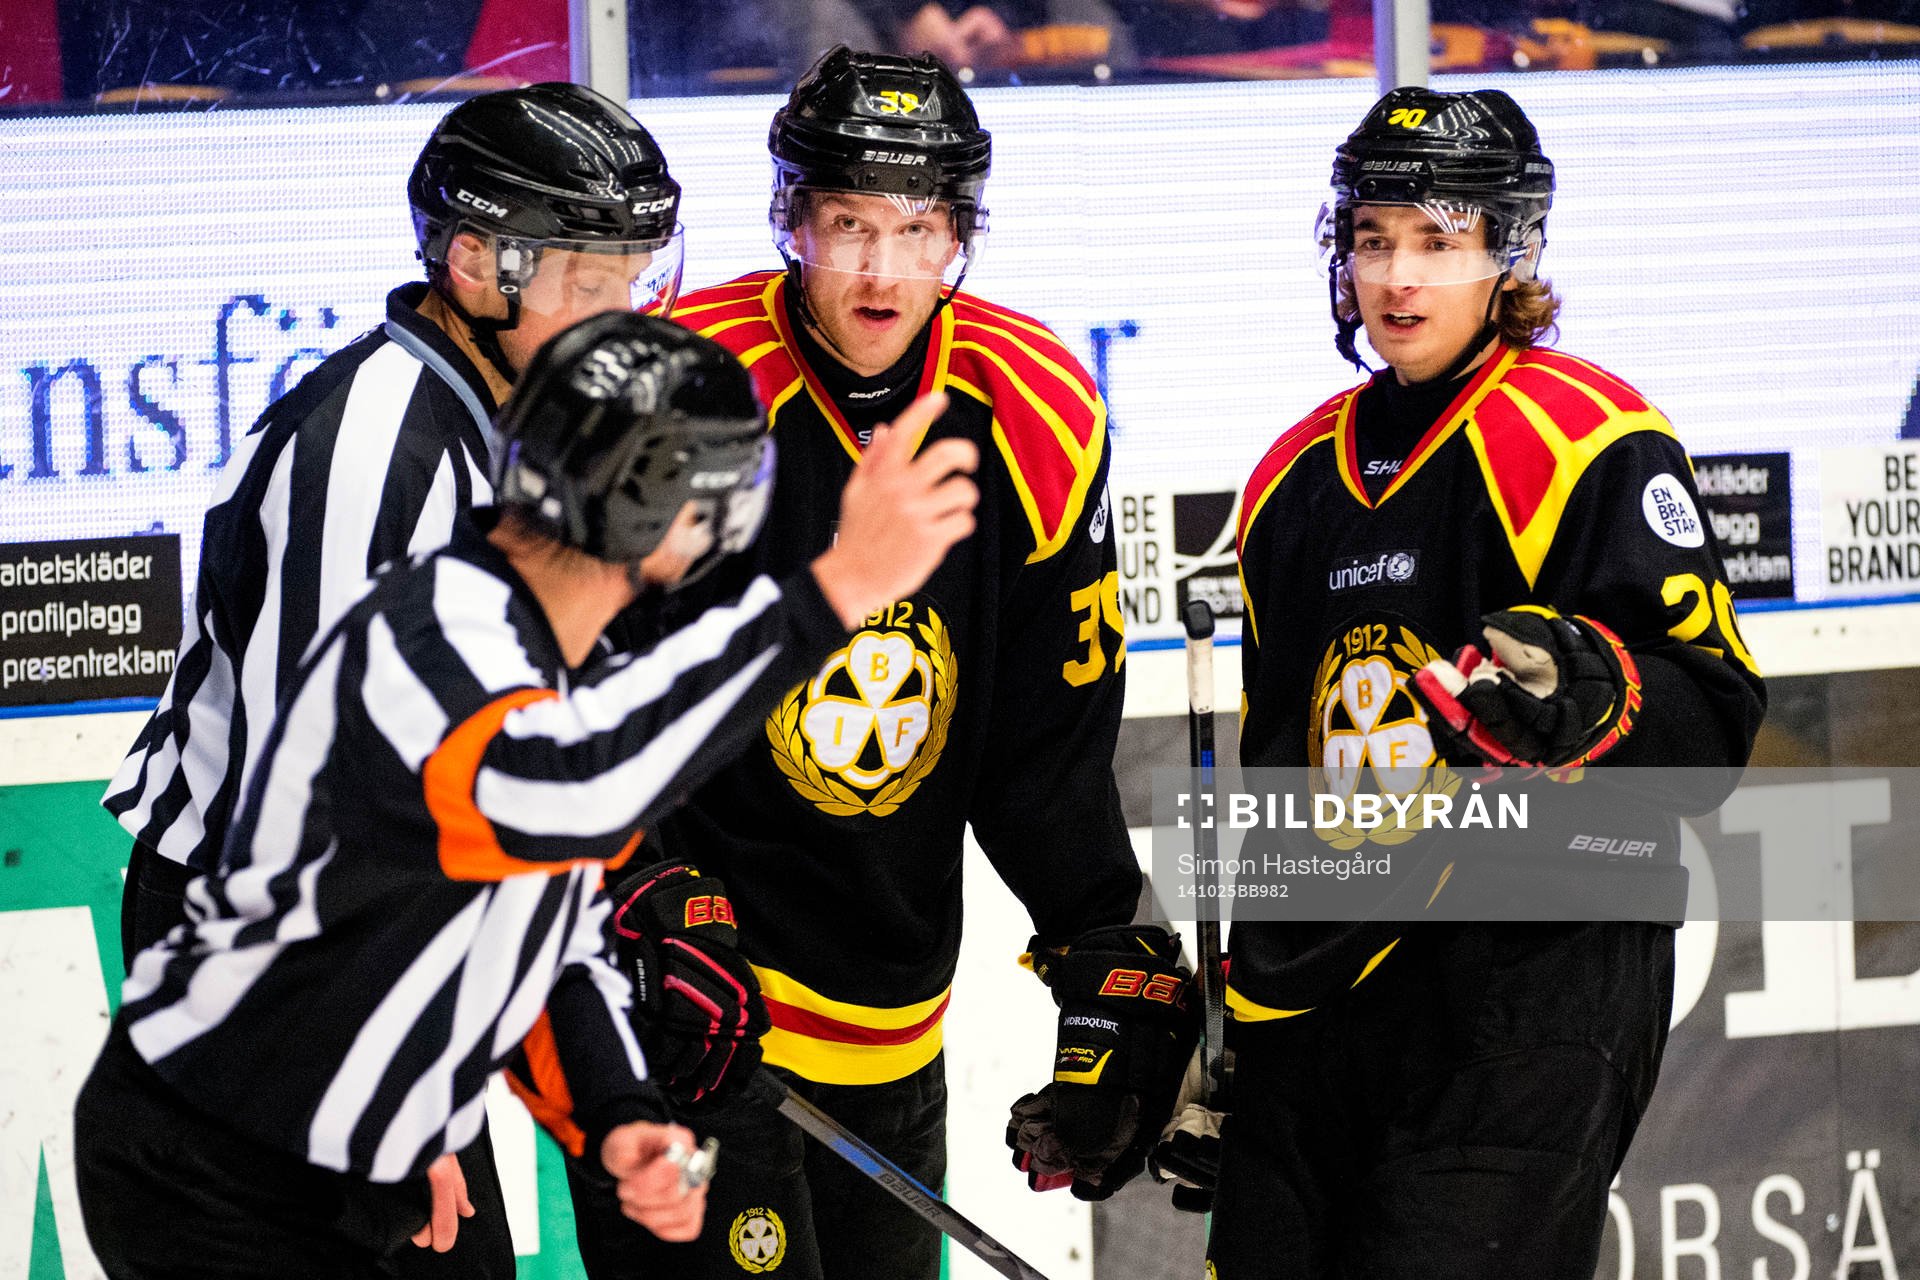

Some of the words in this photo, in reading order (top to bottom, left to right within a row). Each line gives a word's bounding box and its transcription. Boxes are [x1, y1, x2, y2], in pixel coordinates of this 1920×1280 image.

[880, 91, 919, 114] 39
[1388, 108, 1427, 129] 20
[862, 150, 927, 166] BAUER
[456, 188, 508, 218] CCM
[632, 195, 675, 215] CCM
[1363, 460, 1403, 475] SHL
[1885, 454, 1919, 491] BE
[1651, 487, 1673, 504] EN
[1658, 502, 1688, 520] BRA
[1123, 495, 1156, 534] BE
[0, 550, 153, 587] arbetskläder
[1329, 554, 1388, 590] unicef
[1, 600, 142, 641] profilplagg
[1343, 624, 1388, 658] 1912
[3, 644, 176, 689] presentreklam
[868, 652, 890, 682] B
[1357, 678, 1373, 710] B
[894, 716, 914, 748] F
[1389, 740, 1409, 773] F
